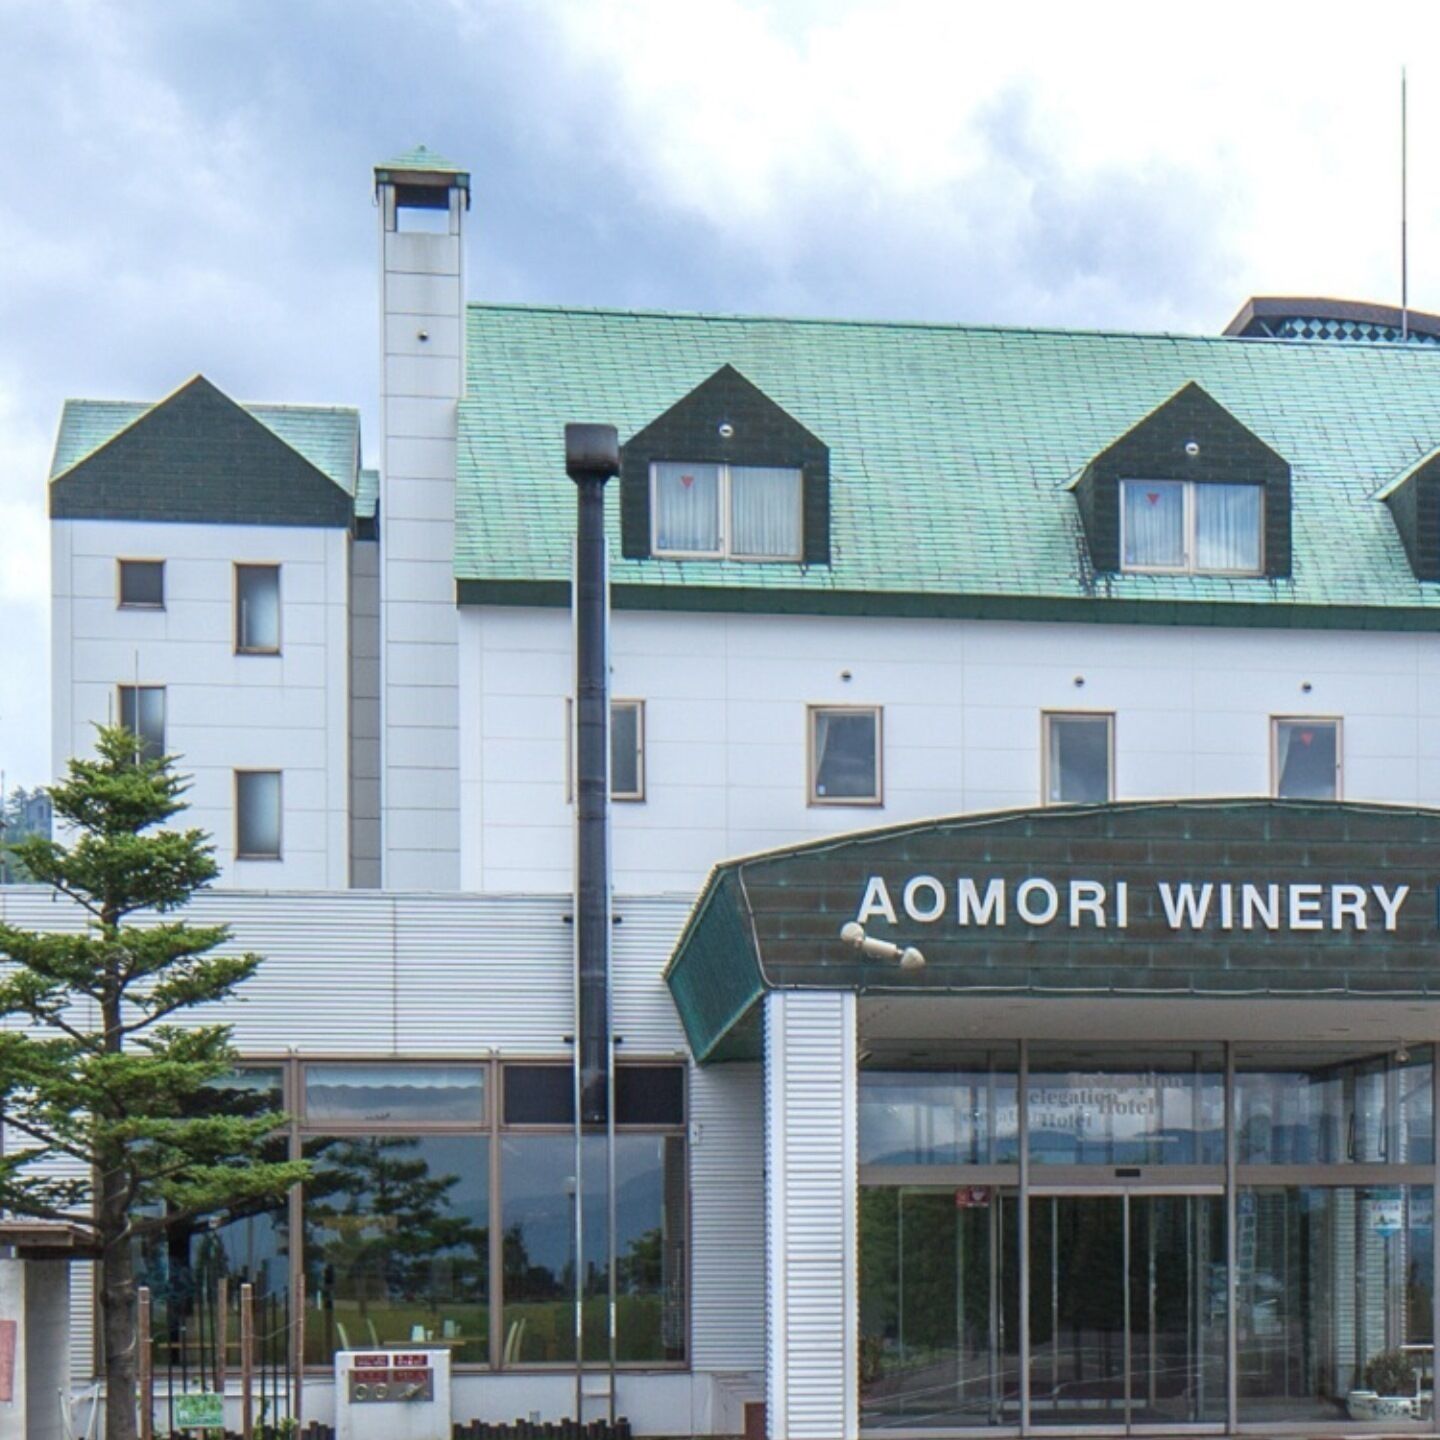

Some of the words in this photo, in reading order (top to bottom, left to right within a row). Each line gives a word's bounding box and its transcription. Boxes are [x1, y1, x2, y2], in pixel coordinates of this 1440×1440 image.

[859, 876, 1129, 928] AOMORI
[1159, 883, 1410, 930] WINERY
[1018, 1089, 1119, 1108] elegation
